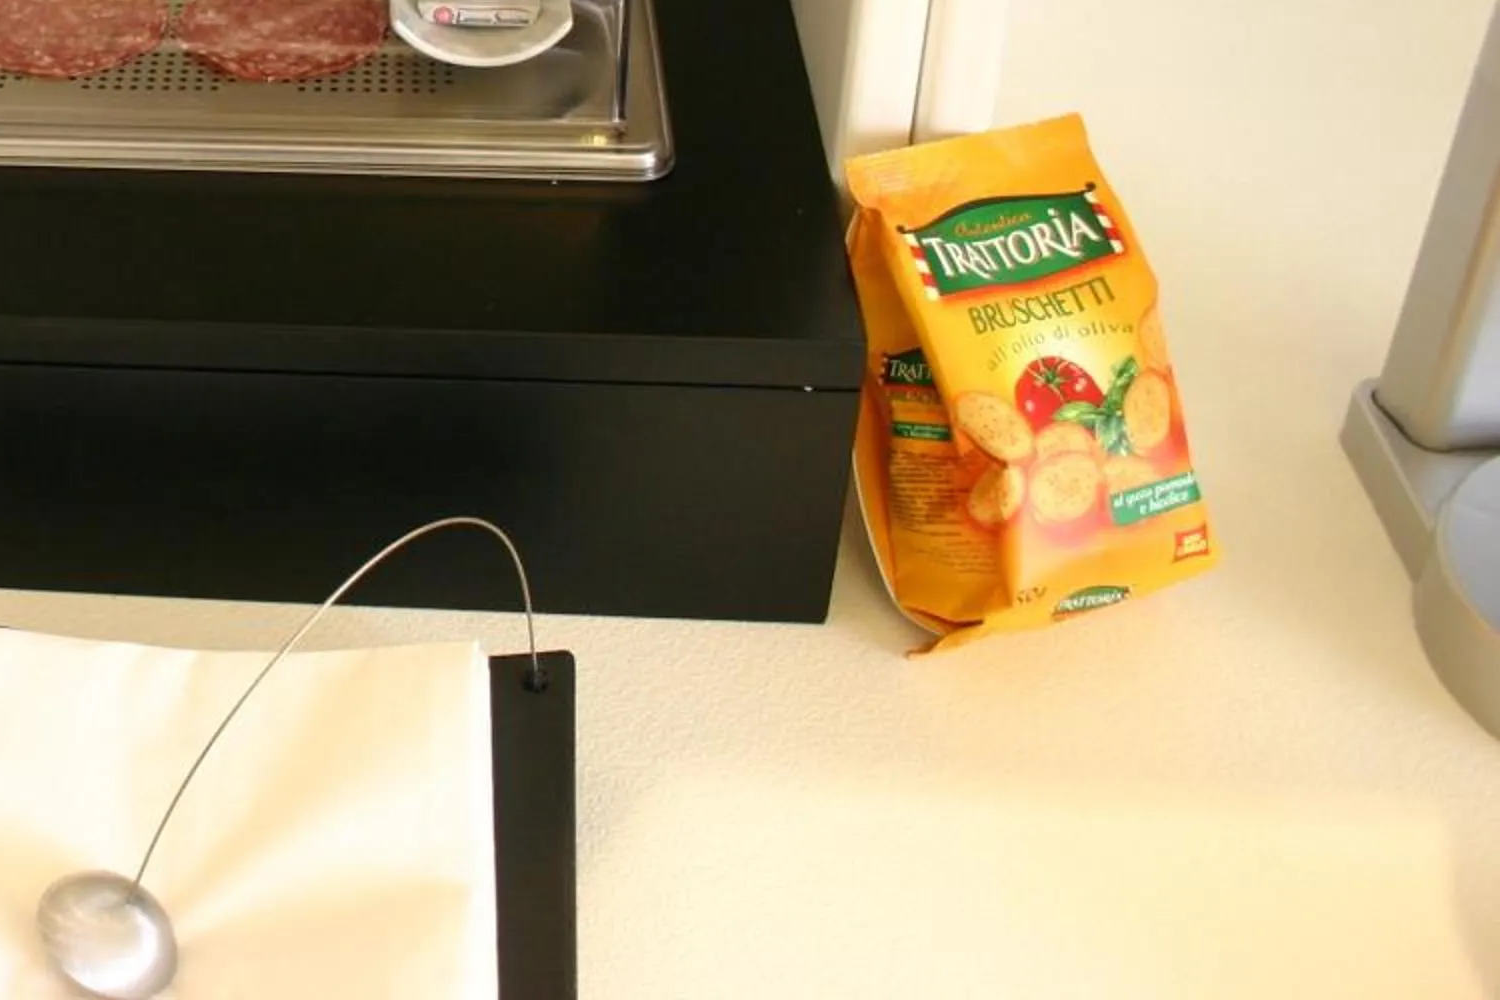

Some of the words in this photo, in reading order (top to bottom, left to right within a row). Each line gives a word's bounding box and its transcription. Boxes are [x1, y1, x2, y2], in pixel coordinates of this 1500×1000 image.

[968, 276, 1115, 335] BRUSCHETTI
[1055, 324, 1070, 340] di
[1078, 321, 1135, 337] oliva
